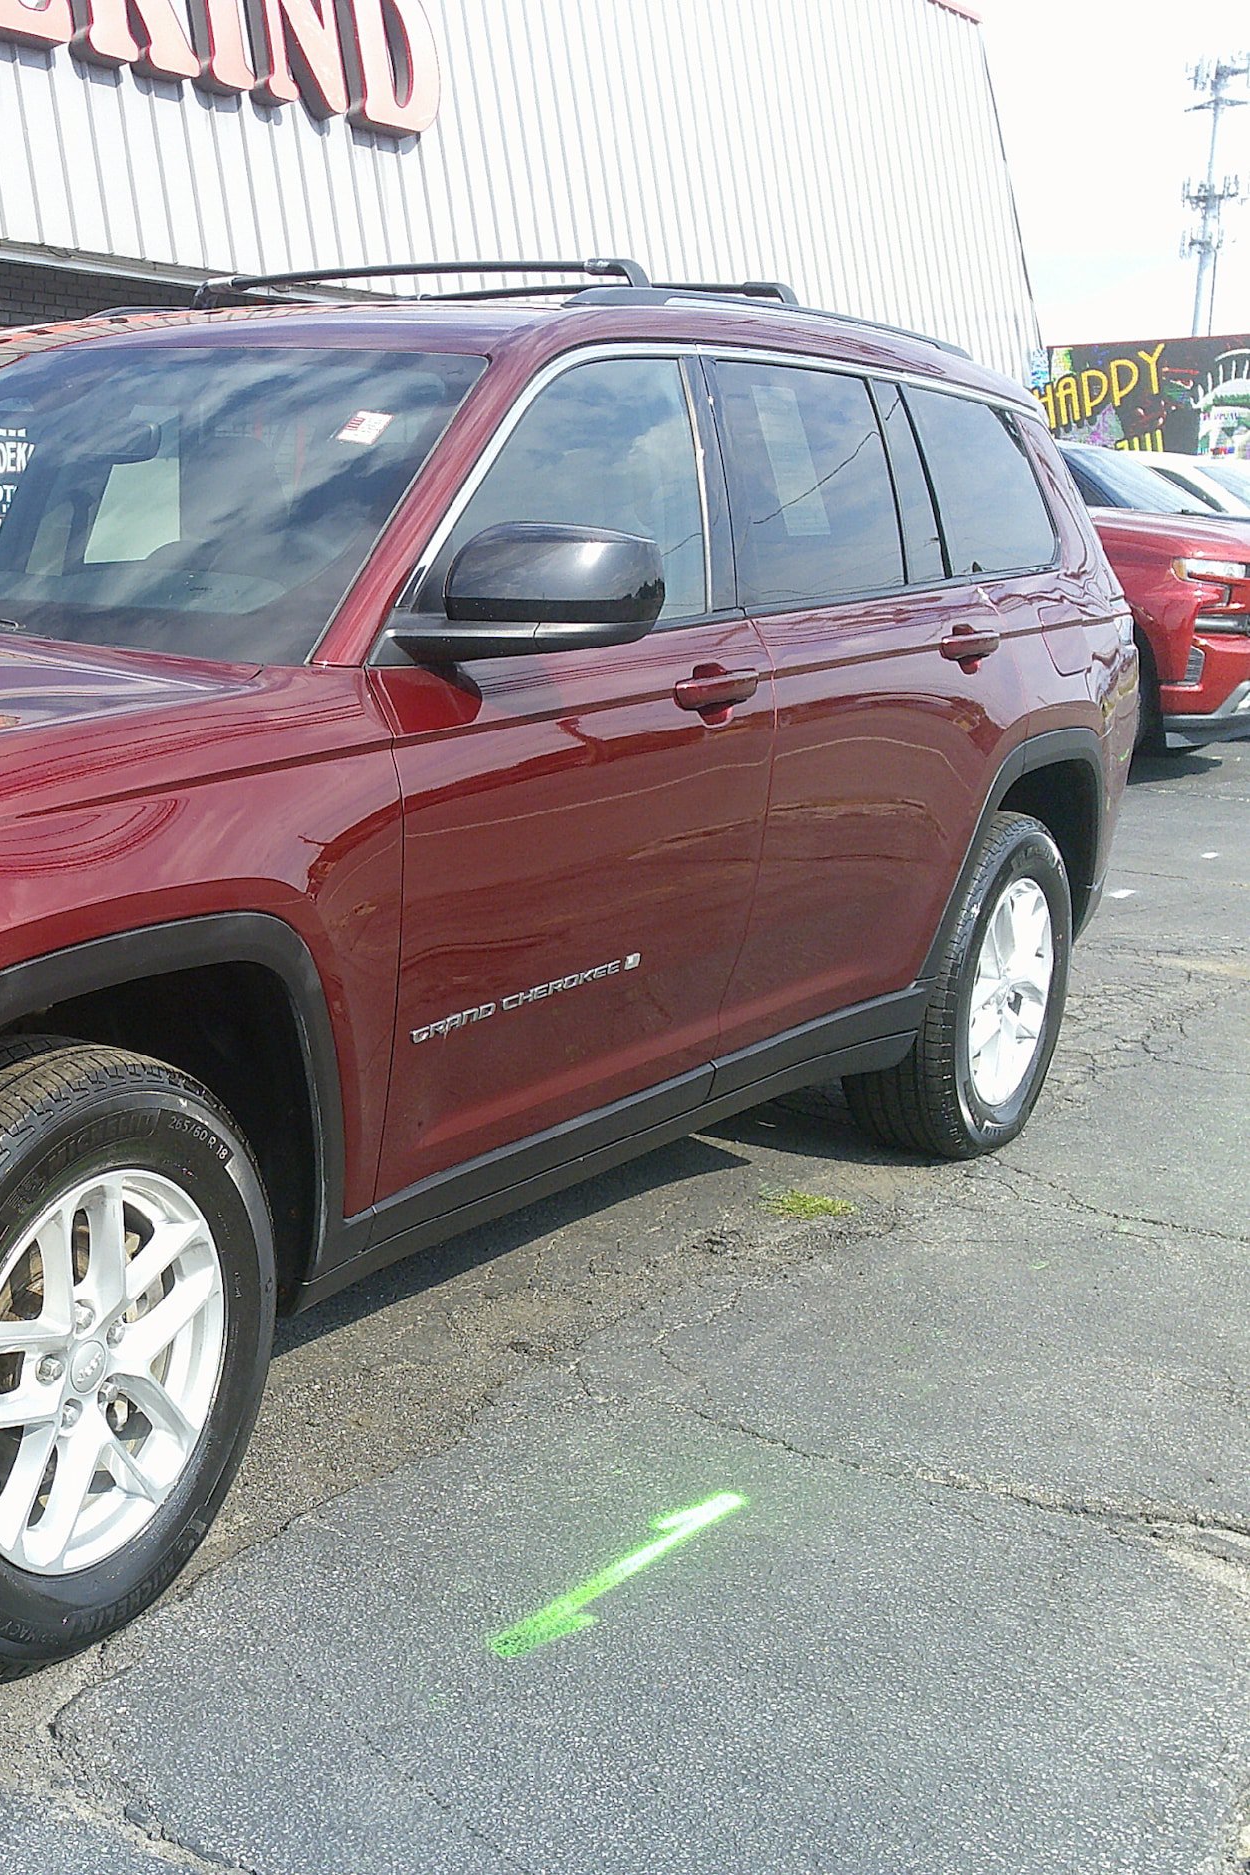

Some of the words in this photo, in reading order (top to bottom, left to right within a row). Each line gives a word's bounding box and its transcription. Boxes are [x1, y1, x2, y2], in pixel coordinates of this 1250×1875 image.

[1034, 343, 1165, 429] HAPPY
[410, 1002, 496, 1044] GRAND
[501, 960, 621, 1012] CHEROKEE
[49, 1113, 152, 1169] MICHELIN
[168, 1115, 210, 1142] 265/60
[207, 1135, 217, 1150] R
[216, 1145, 229, 1160] 18
